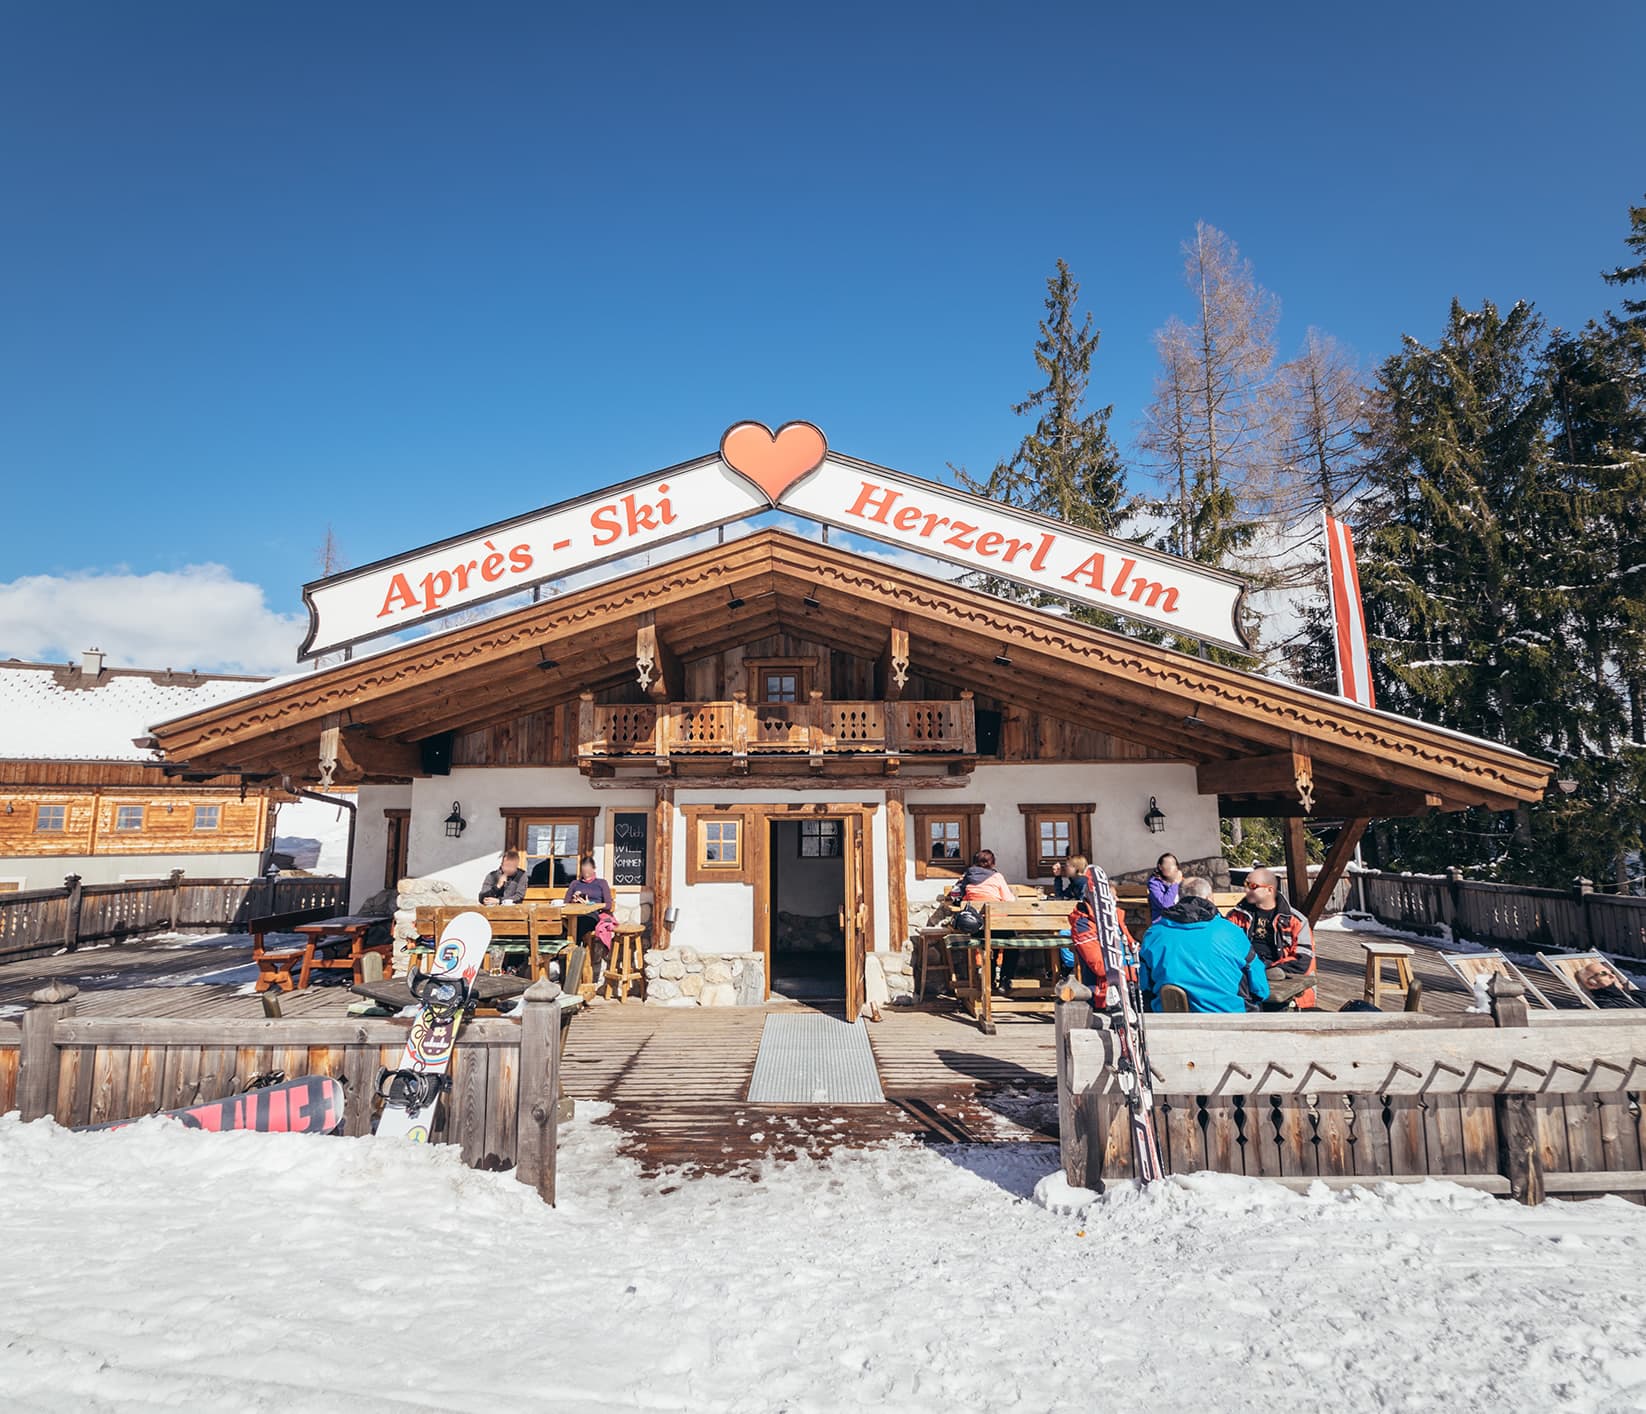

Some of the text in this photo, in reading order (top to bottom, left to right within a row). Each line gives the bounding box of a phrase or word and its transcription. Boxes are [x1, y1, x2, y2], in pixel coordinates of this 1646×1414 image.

[376, 540, 534, 619] Après
[590, 483, 679, 547] Ski
[844, 481, 1179, 613] Herzerl Alm
[1093, 866, 1124, 971] FISCHER
